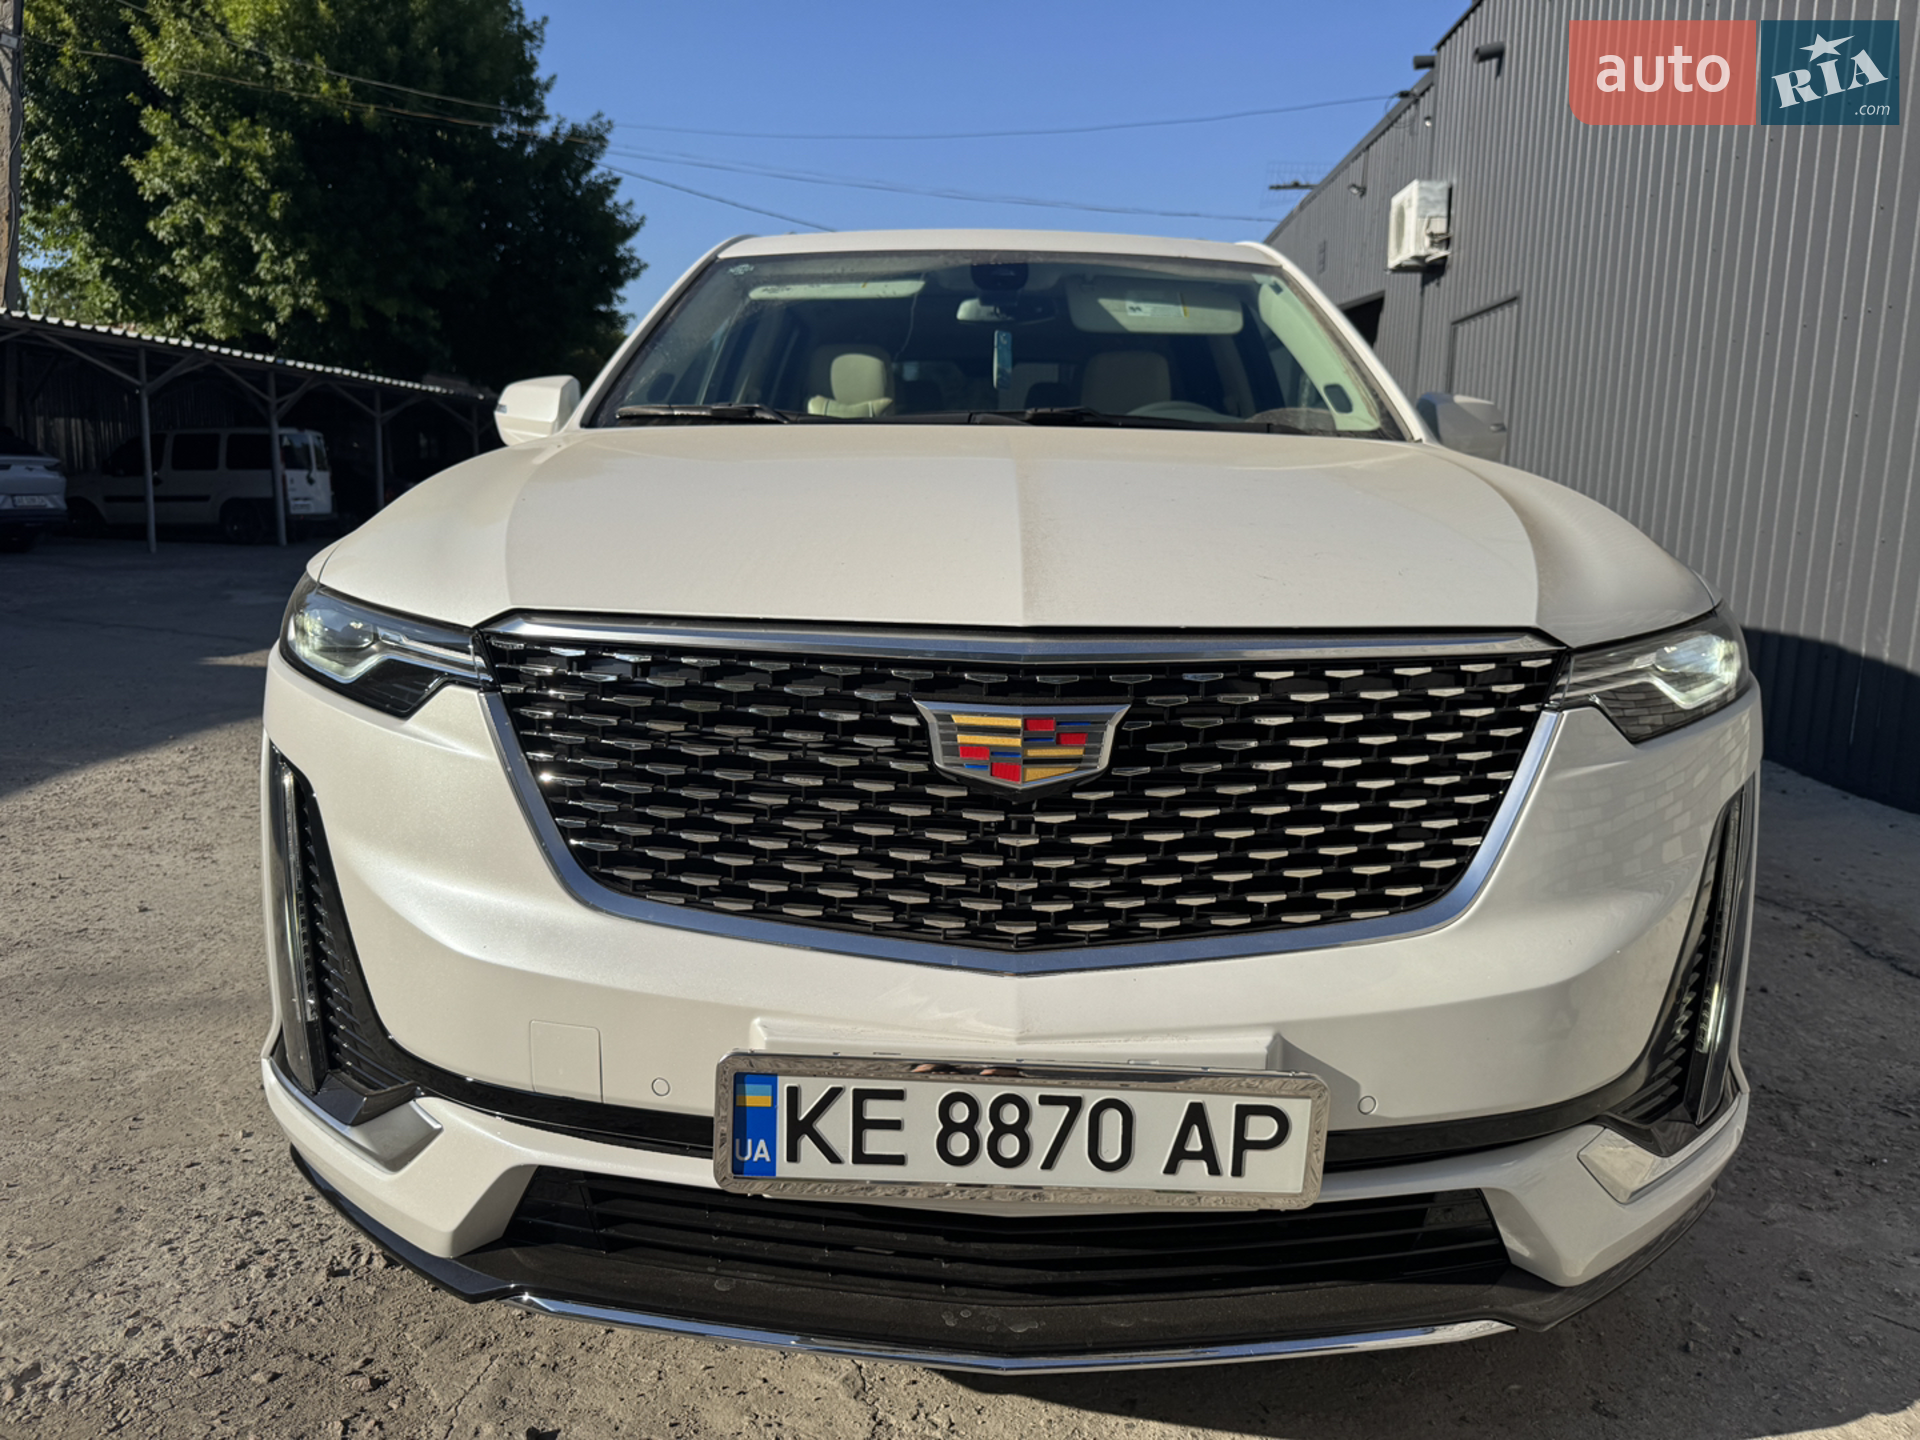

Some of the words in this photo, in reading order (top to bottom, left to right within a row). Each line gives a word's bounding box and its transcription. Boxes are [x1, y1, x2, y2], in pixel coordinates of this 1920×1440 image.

[735, 1138, 771, 1163] UA
[786, 1085, 907, 1166] KE
[935, 1091, 1134, 1173] 8870
[1162, 1101, 1291, 1178] AP
